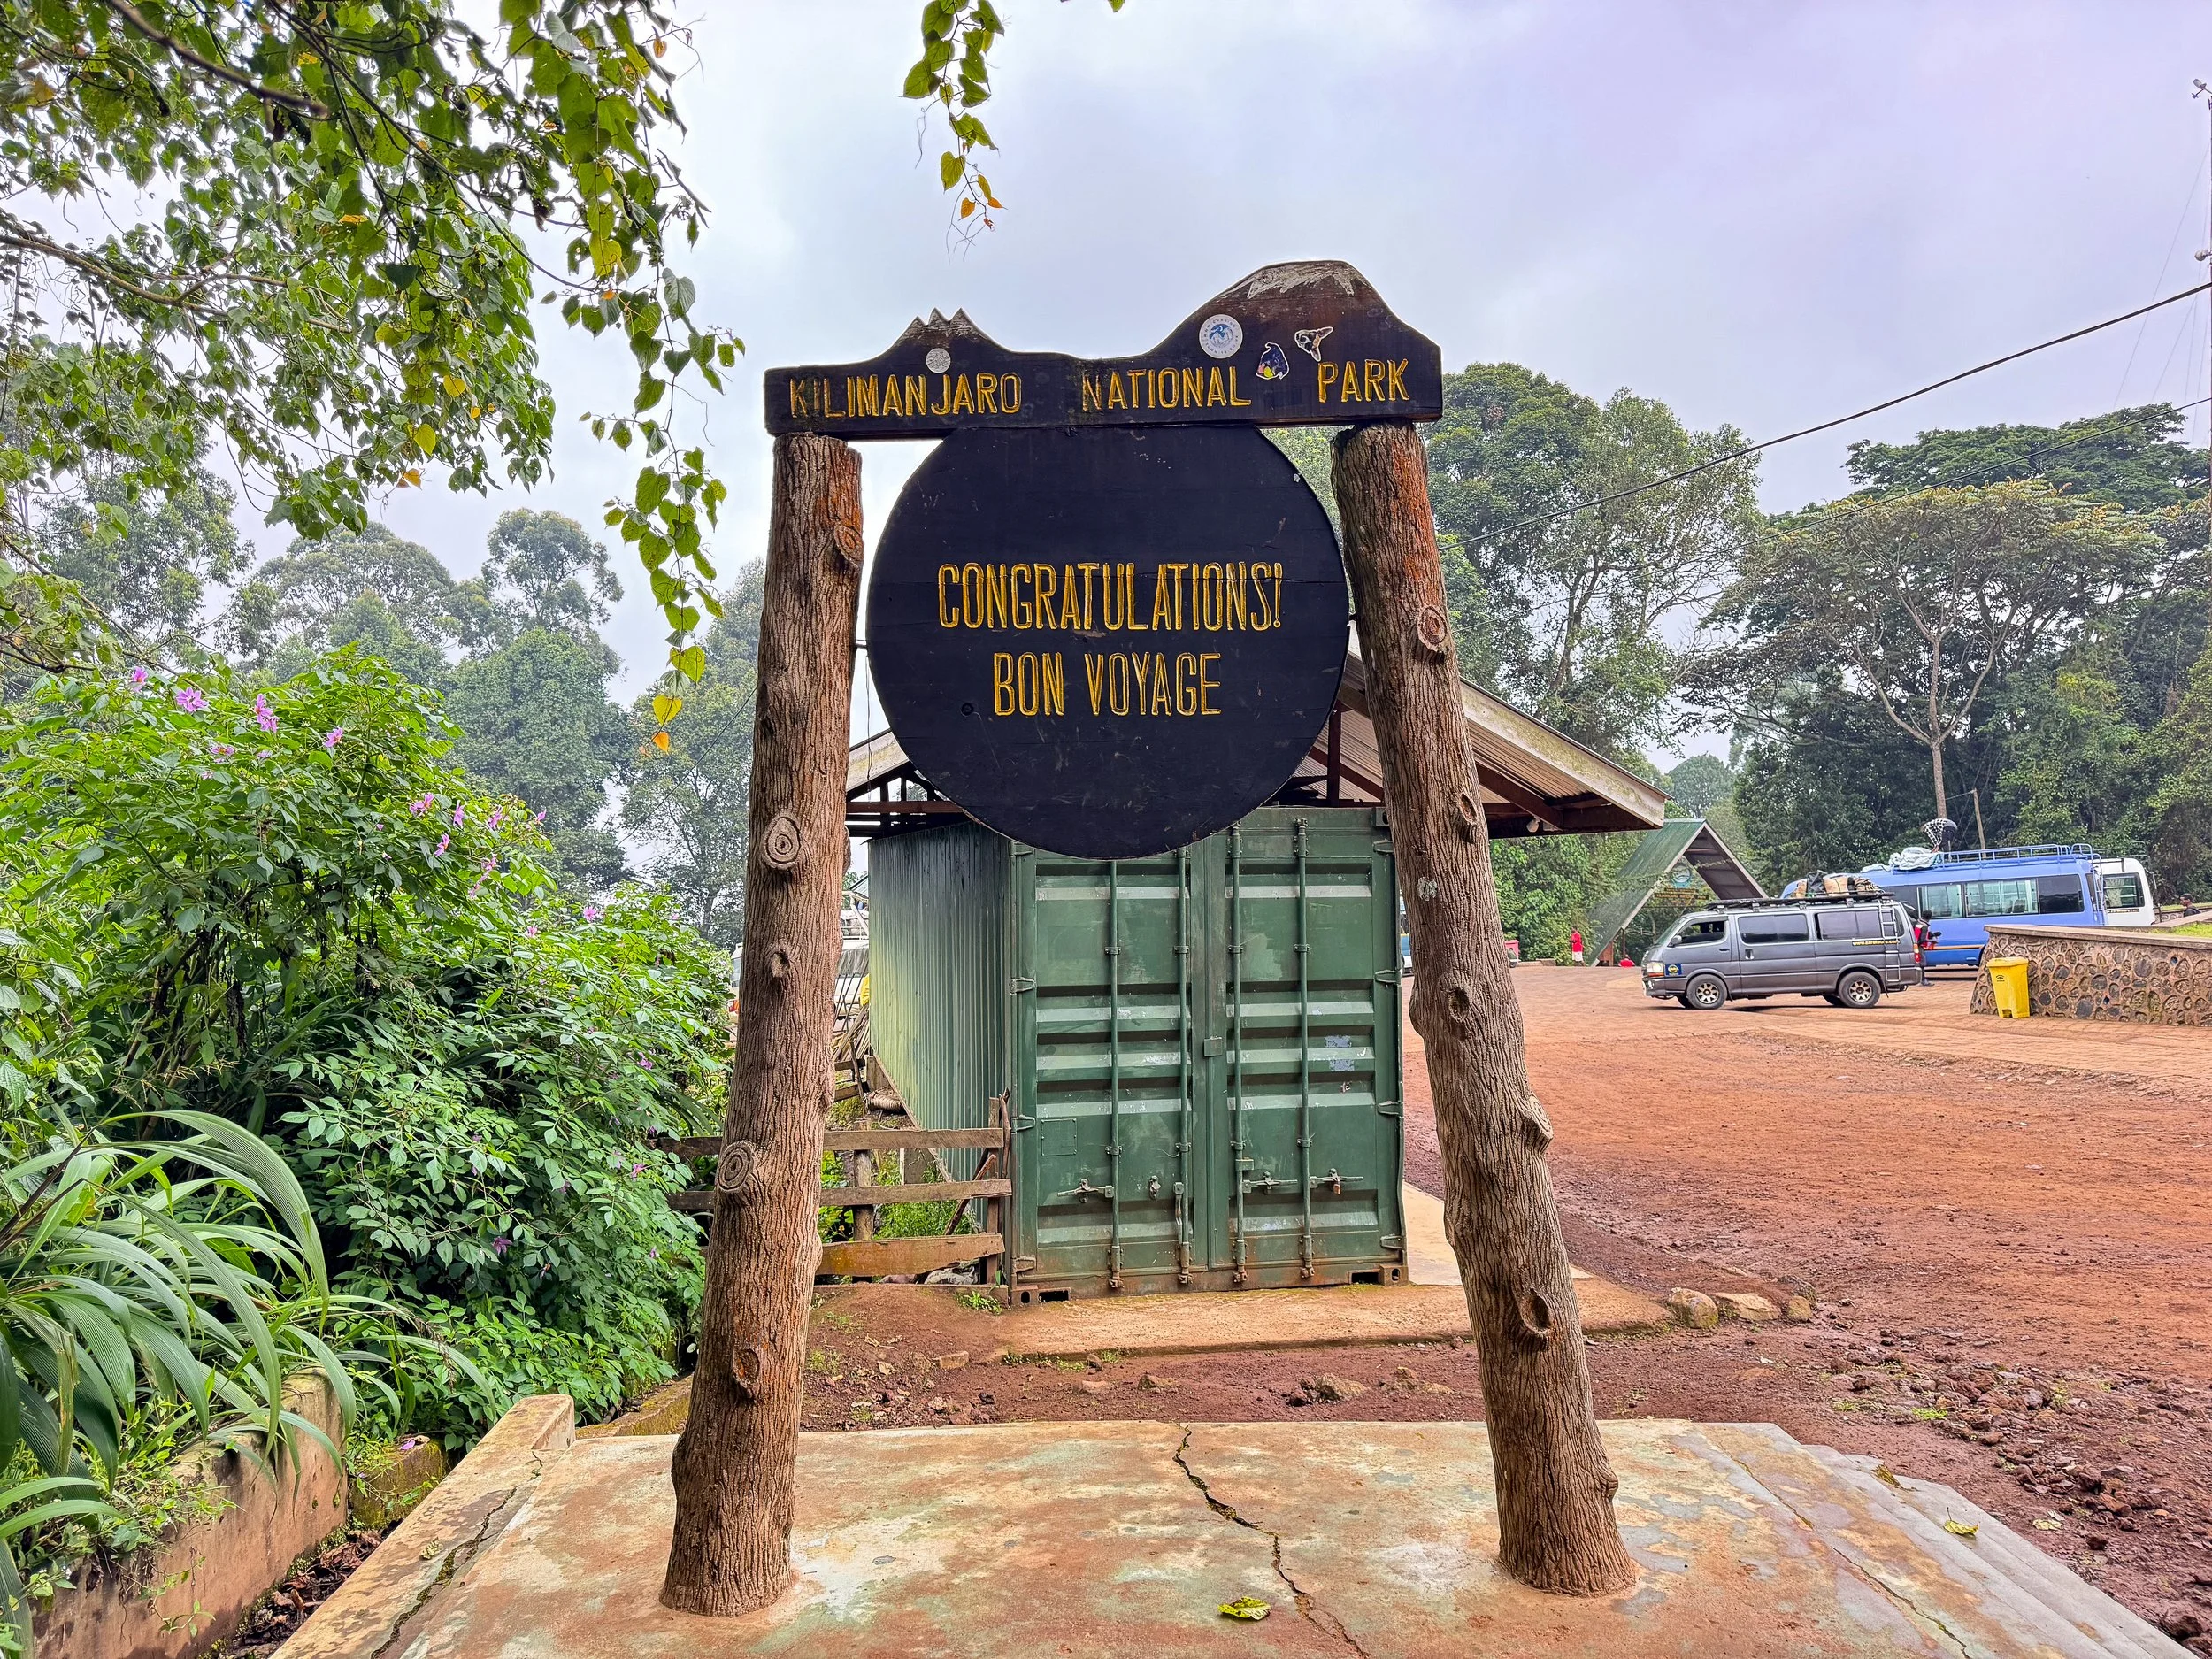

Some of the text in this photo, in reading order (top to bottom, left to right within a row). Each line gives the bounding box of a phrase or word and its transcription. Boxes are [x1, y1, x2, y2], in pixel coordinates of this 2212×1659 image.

[790, 358, 1411, 418] KILIMANJARO NATIONAL PARK
[938, 562, 1283, 631] CONGRATULATIONS!
[994, 652, 1222, 717] BON VOYAGE
